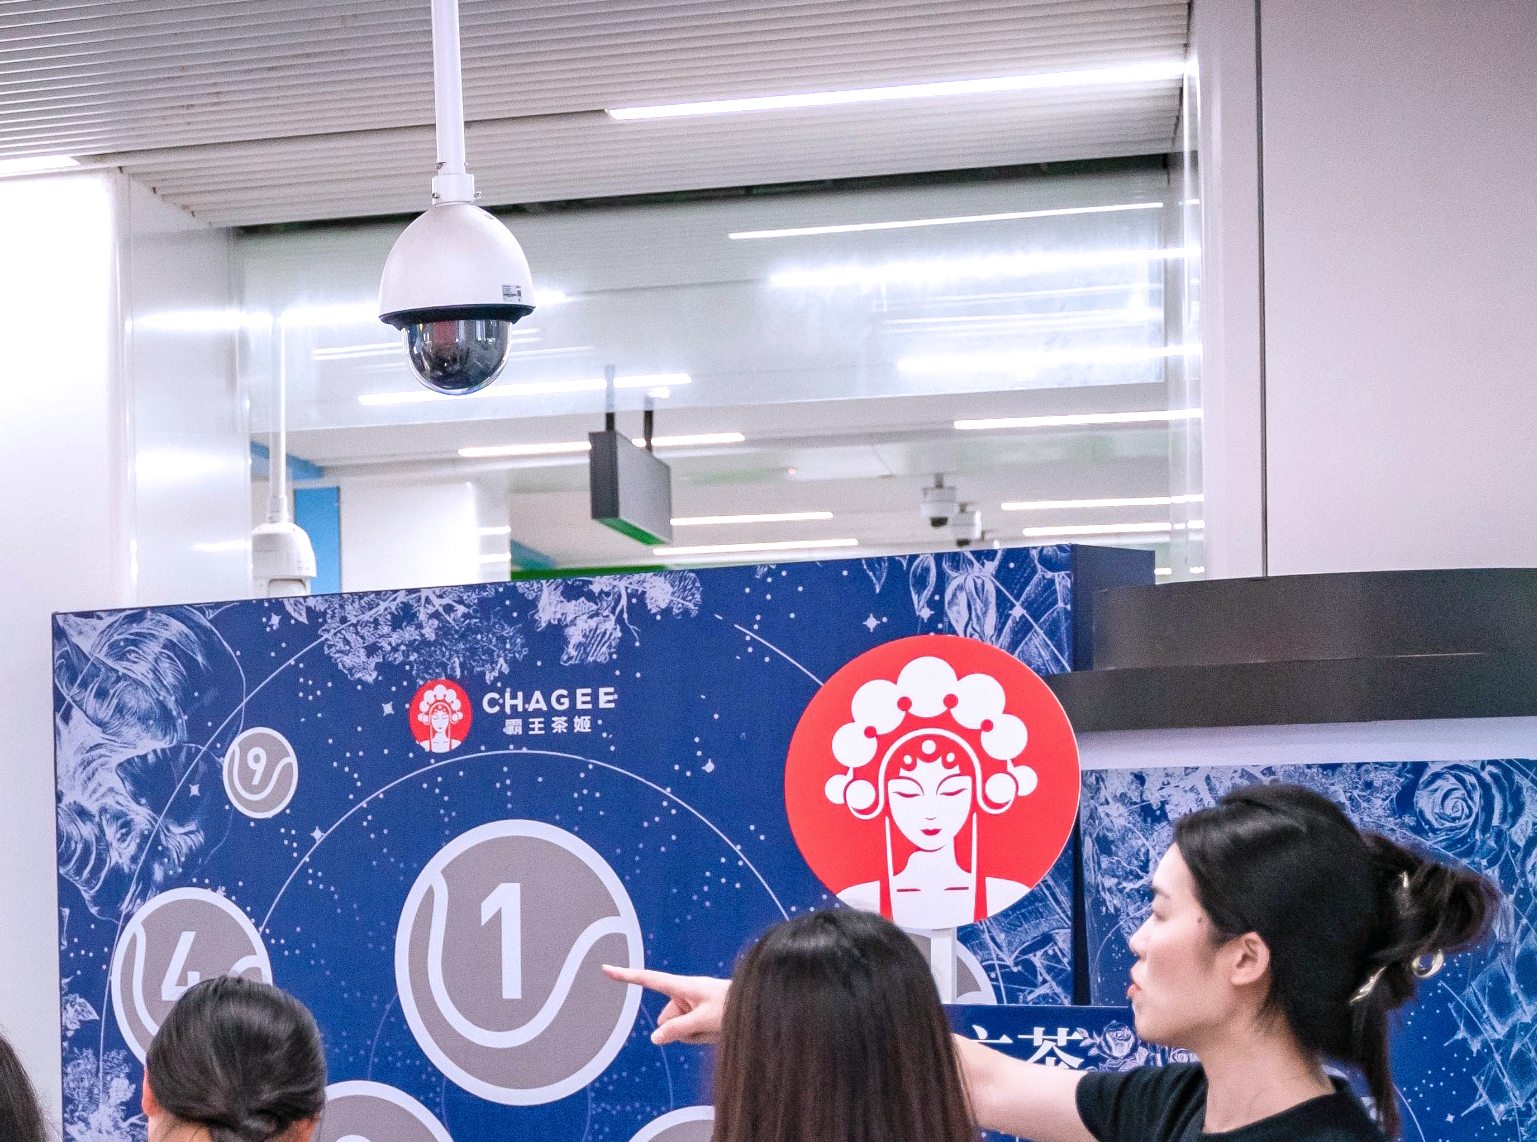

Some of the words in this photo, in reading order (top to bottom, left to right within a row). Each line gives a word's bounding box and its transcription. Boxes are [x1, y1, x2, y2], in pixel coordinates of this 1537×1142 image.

[482, 687, 616, 714] CHAGEE
[504, 715, 592, 736] 霸王茶姬
[246, 746, 268, 786] 9
[480, 882, 524, 1000] 1
[161, 930, 201, 1001] 4
